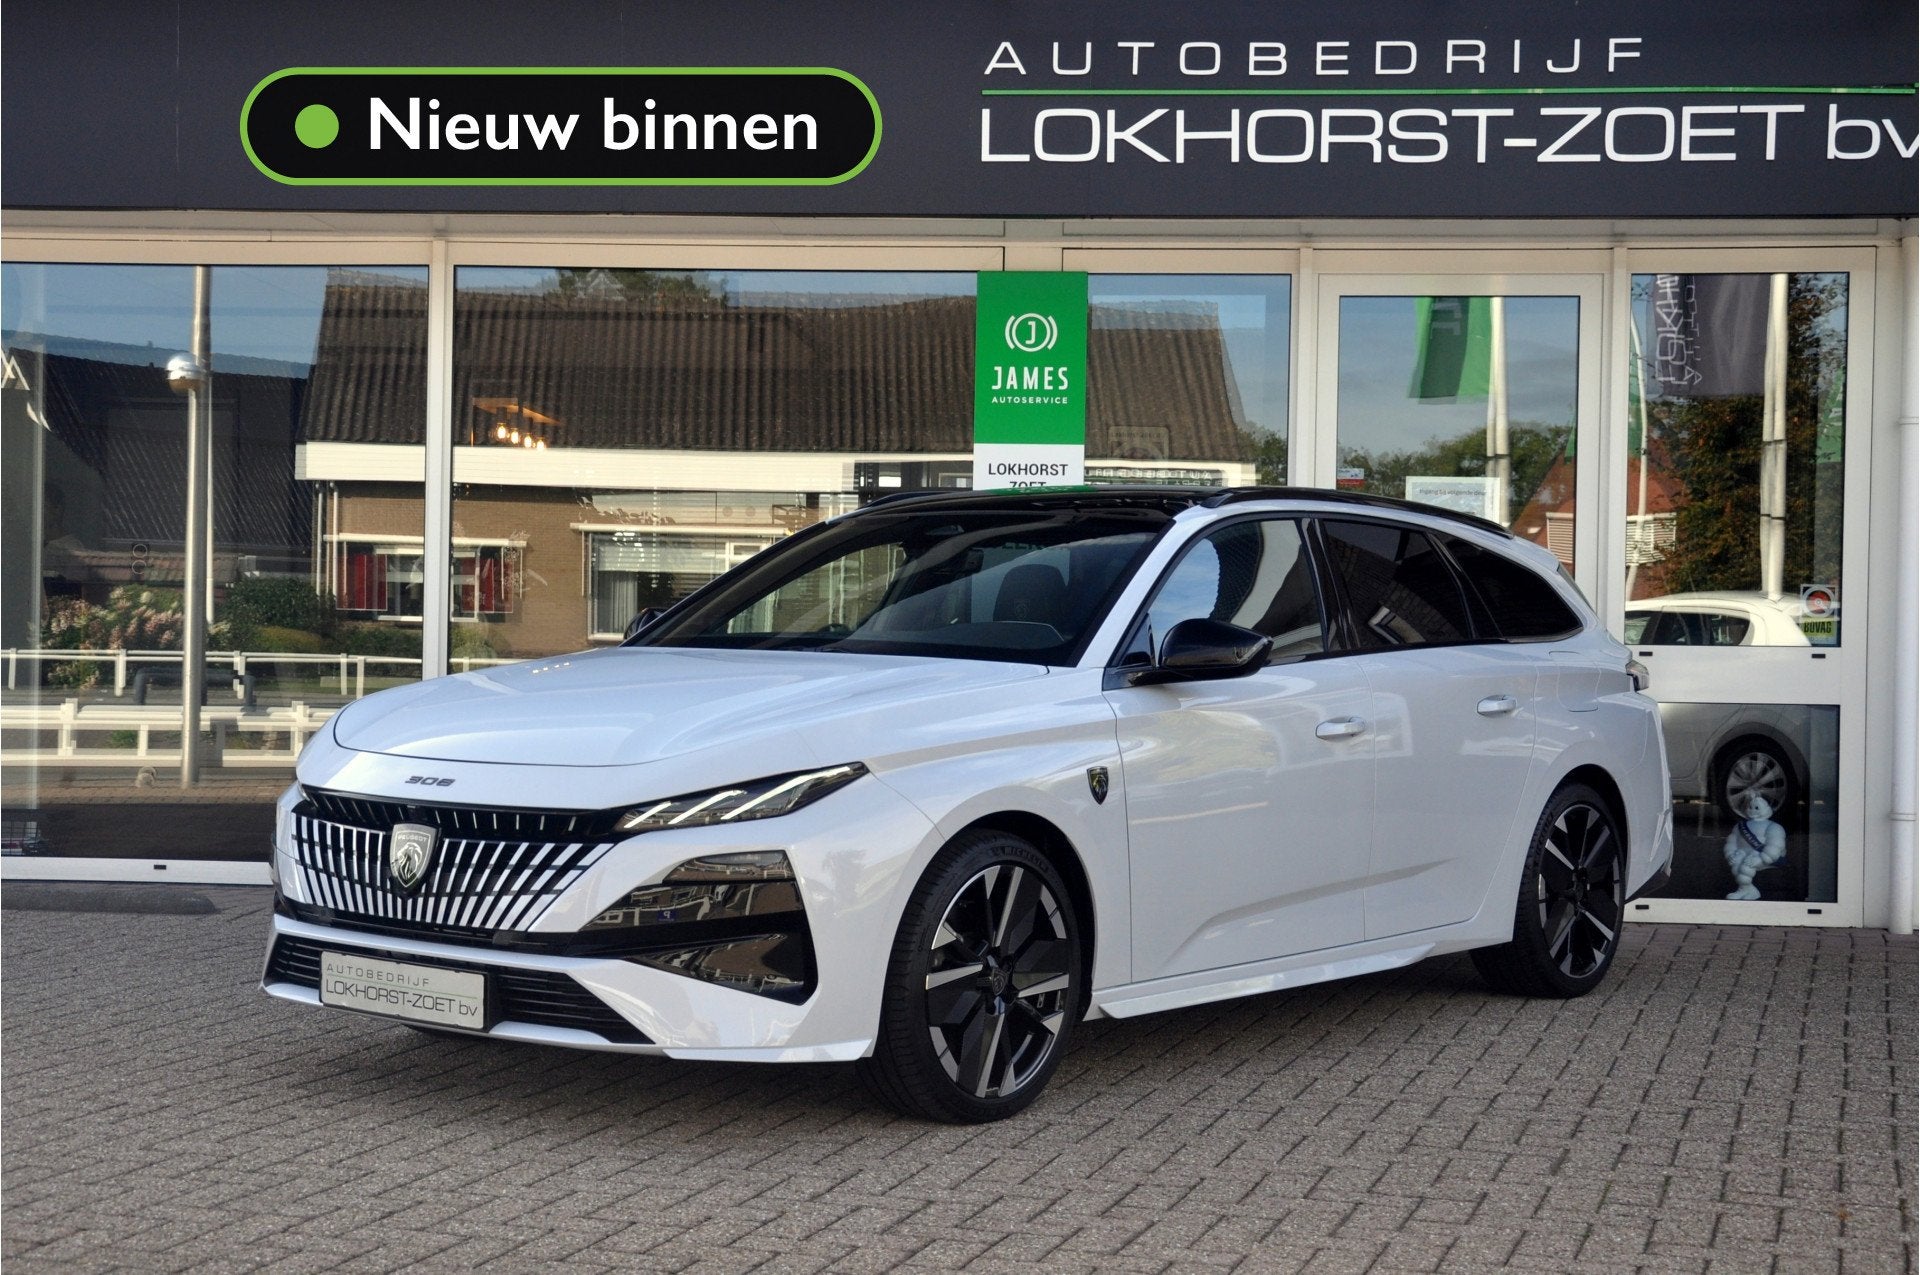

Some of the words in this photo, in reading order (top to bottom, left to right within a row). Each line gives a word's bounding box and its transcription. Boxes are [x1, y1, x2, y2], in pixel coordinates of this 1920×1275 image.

[984, 37, 1642, 75] AUTOBEDRIJF
[981, 104, 1805, 164] LOKHORST-ZOET
[1826, 103, 1920, 160] bv
[991, 366, 1069, 390] JAMES
[991, 396, 1069, 404] AUTOSERVICE
[988, 463, 1069, 476] LOKHORST
[1804, 621, 1832, 634] BOVAG
[404, 775, 456, 787] 308
[326, 963, 430, 987] AUTOBEDRIJF
[326, 979, 456, 1013] LOKHORST-ZOET
[458, 1000, 478, 1017] bv
